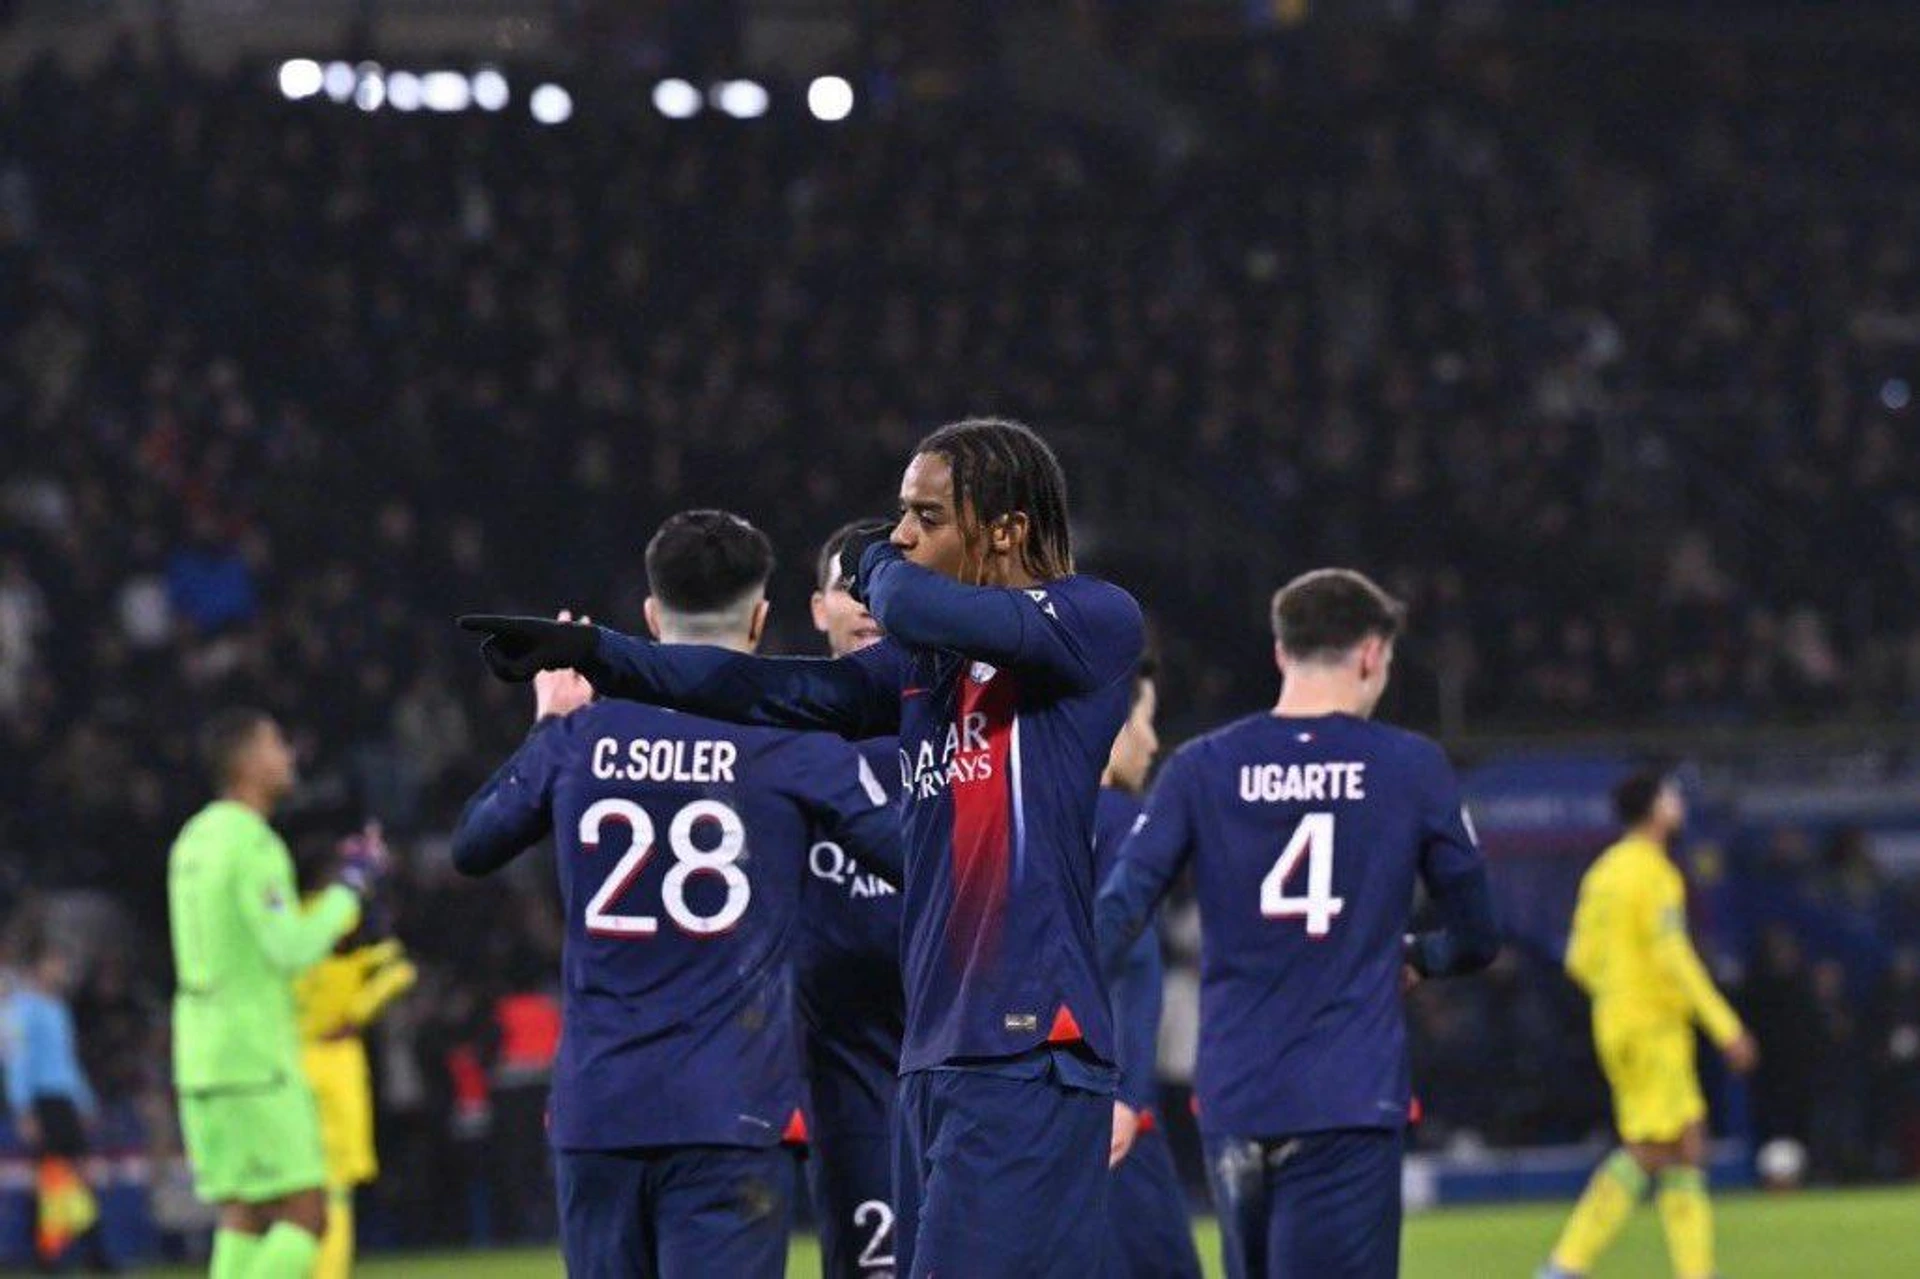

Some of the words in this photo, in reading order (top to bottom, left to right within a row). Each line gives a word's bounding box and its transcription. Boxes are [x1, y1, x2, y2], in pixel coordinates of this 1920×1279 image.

[591, 737, 737, 782] C.SOLER
[899, 711, 990, 794] QAAR
[917, 753, 993, 801] RAYS
[1239, 761, 1366, 802] UGARTE
[578, 798, 750, 939] 28
[1259, 812, 1345, 941] 4
